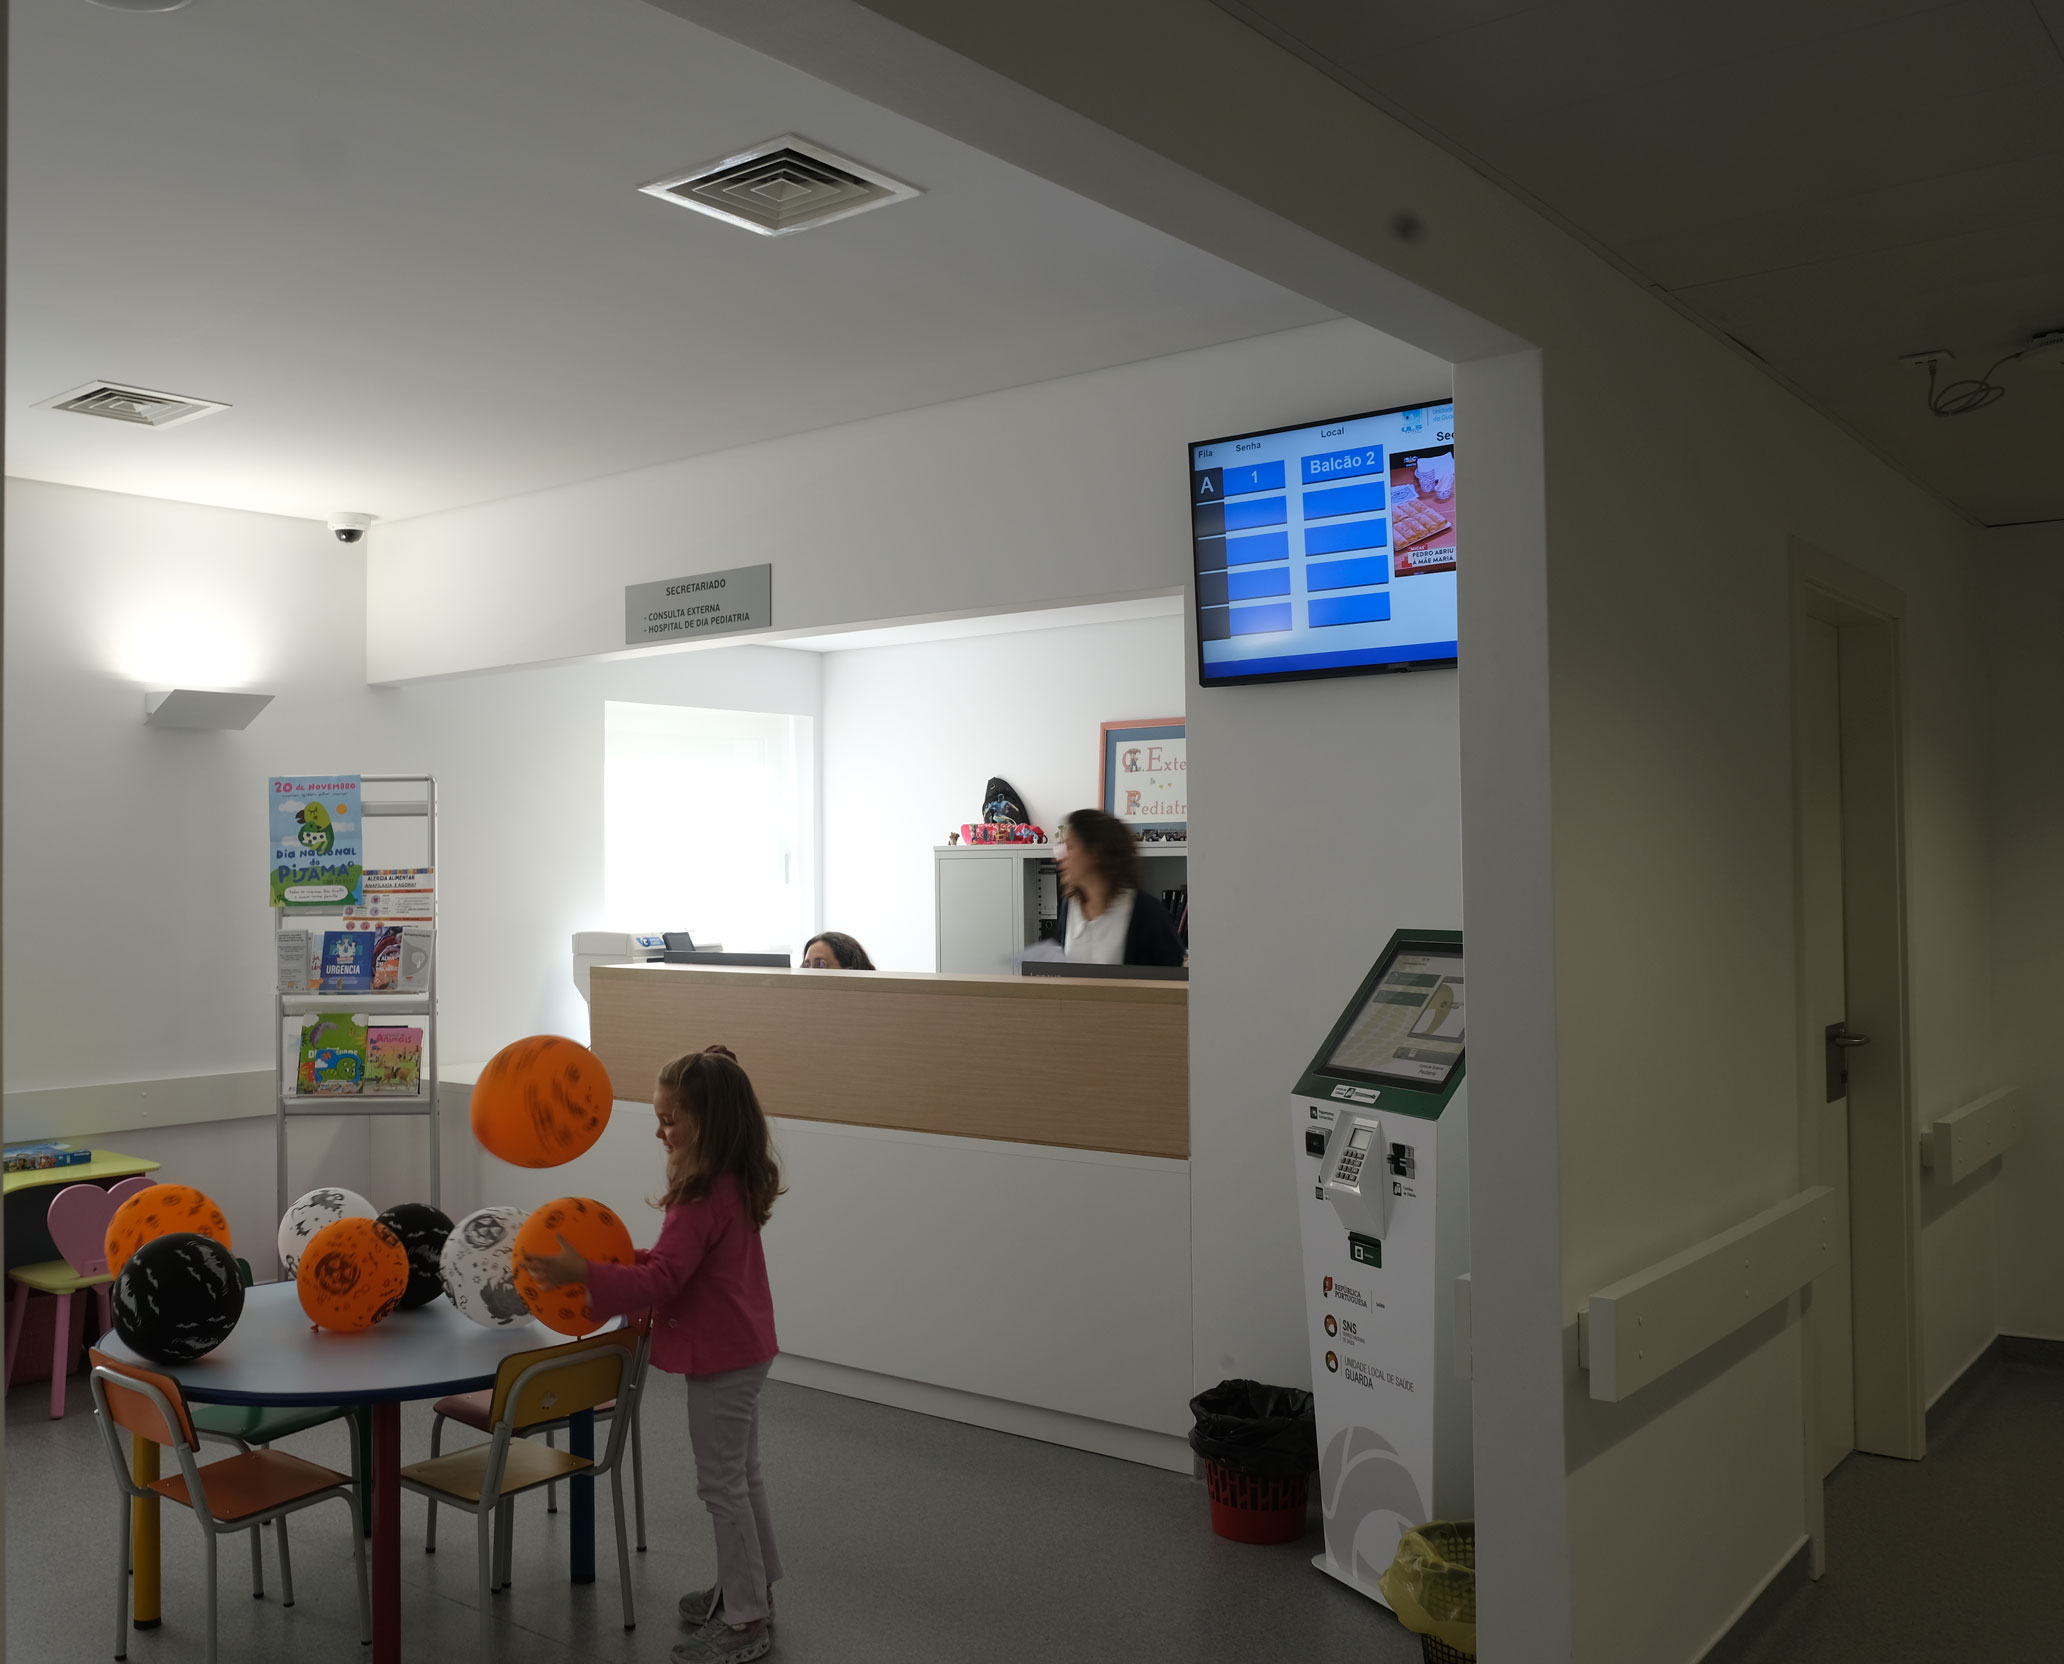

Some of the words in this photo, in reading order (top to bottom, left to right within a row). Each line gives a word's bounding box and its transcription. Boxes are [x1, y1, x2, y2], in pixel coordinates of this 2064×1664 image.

[1320, 427, 1345, 438] Local
[1235, 441, 1261, 452] Senha
[1198, 450, 1213, 459] Fila
[1310, 455, 1361, 475] Balcão
[1366, 452, 1375, 466] 2
[1251, 470, 1259, 484] 1
[1200, 476, 1214, 494] A
[666, 579, 726, 596] SECRETARIADO
[648, 609, 685, 621] CONSULTA
[687, 604, 720, 615] EXTERNA
[648, 622, 682, 634] HOSPITAL
[685, 620, 694, 629] DE
[696, 618, 708, 627] DIA
[710, 612, 750, 625] PEDIATRIA
[274, 781, 293, 793] 20
[308, 782, 356, 791] NOVEMBRO
[276, 850, 296, 859] Dia
[310, 858, 320, 866] do
[376, 1033, 412, 1043] Animais
[1335, 1283, 1361, 1298] REPÚBLICA
[1335, 1291, 1367, 1308] PORTUGUESA
[1343, 1320, 1357, 1334] SNS
[1344, 1356, 1367, 1373] UNIDADE
[1368, 1366, 1385, 1381] LOCAL
[1386, 1373, 1394, 1385] DE
[1395, 1376, 1414, 1392] SAÚDE
[1345, 1368, 1374, 1389] GUARDA
